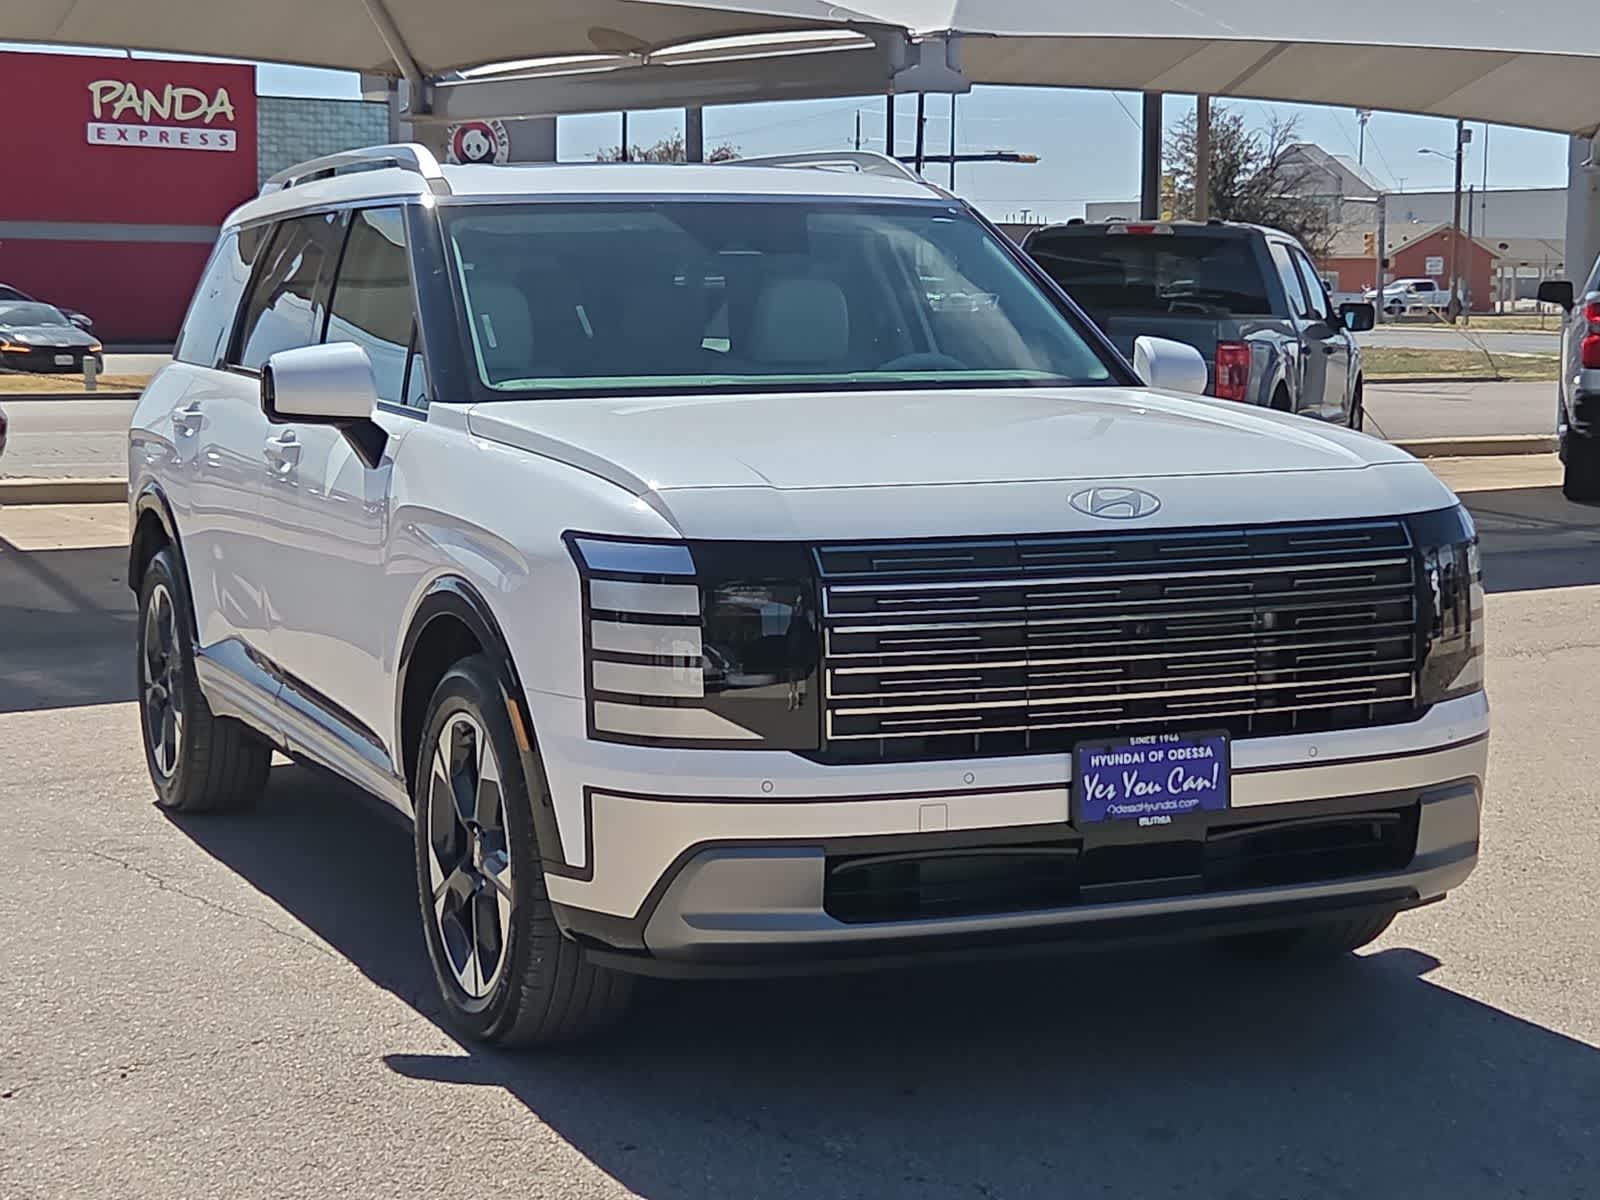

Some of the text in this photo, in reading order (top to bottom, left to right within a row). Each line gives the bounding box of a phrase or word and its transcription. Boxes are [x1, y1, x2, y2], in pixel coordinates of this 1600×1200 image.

[87, 79, 235, 124] PANDA
[96, 127, 229, 147] EXPRESS
[1129, 734, 1156, 746] SINCE
[1091, 746, 1213, 767] HYUNDAI OF ODESSA
[1083, 762, 1219, 801] Yes You Can!
